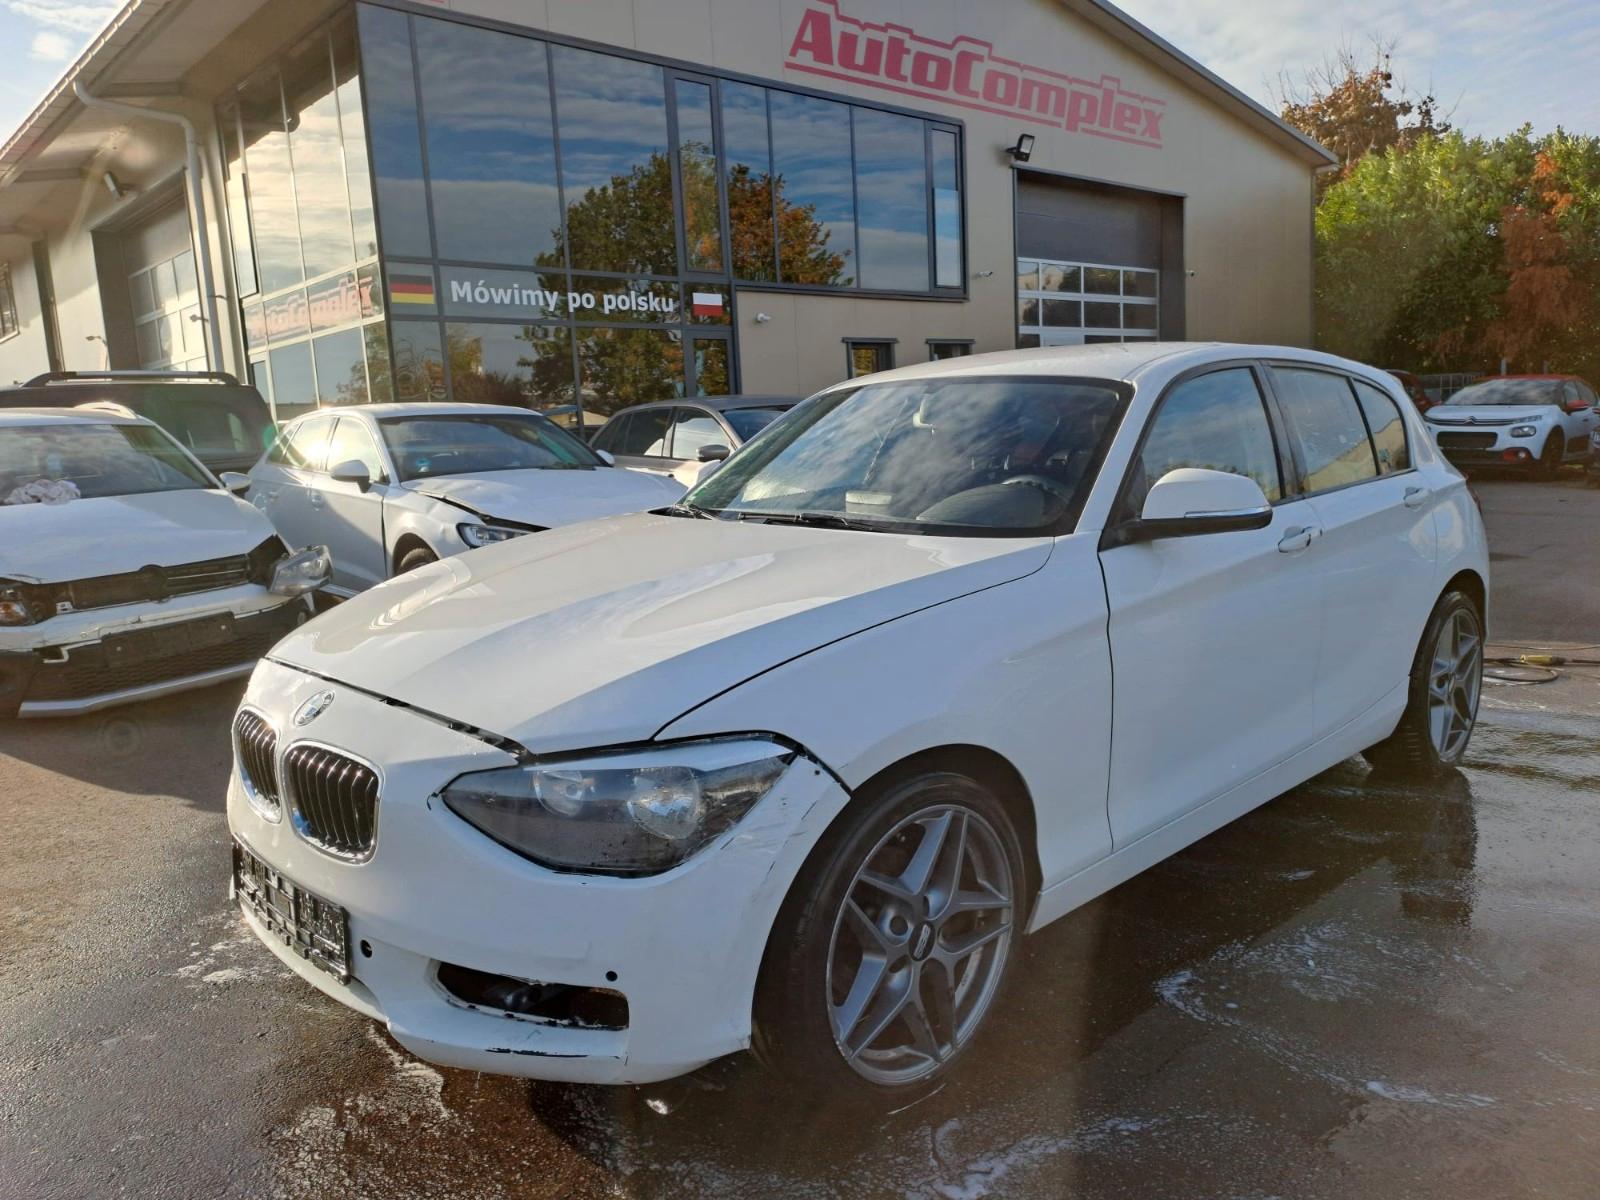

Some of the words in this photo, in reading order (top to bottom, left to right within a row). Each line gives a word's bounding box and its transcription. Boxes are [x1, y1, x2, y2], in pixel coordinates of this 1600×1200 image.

[789, 8, 1163, 139] AutoComplex
[450, 280, 558, 312] Mówimy
[567, 291, 596, 313] po
[602, 290, 674, 314] polsku
